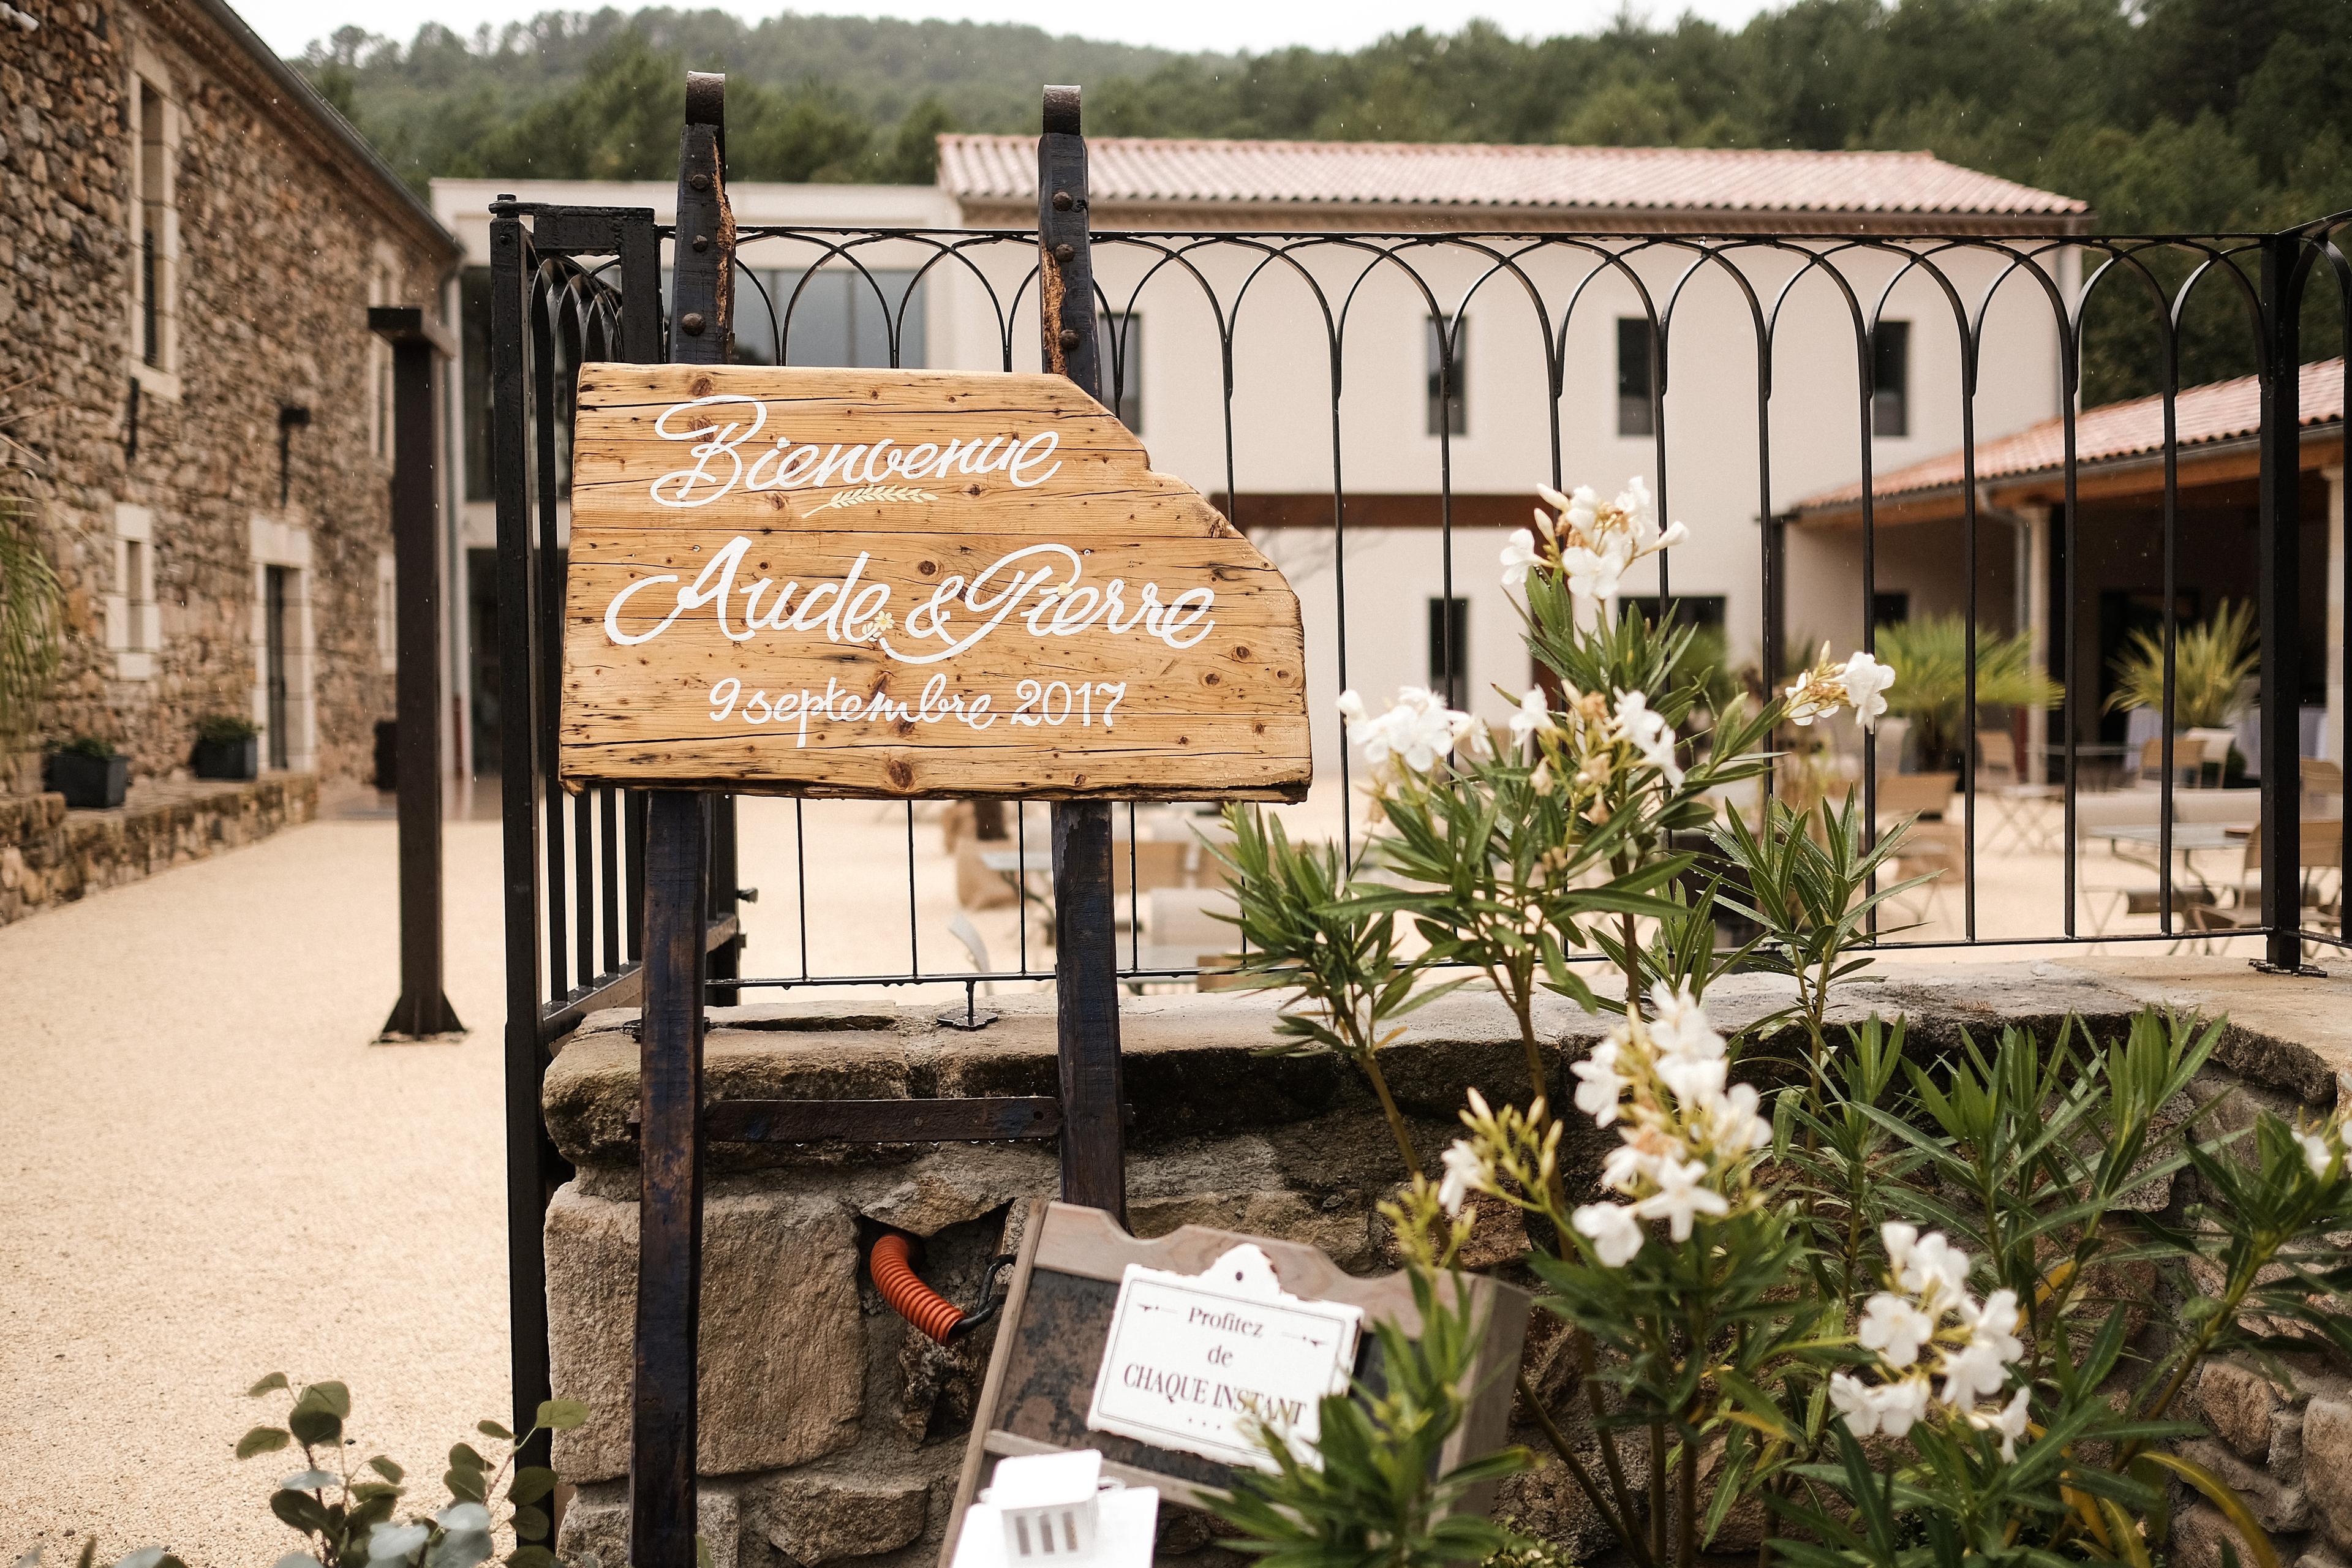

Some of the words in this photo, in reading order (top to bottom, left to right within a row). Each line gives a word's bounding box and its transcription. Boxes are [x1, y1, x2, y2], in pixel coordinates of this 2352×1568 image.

[649, 394, 1062, 507] Bienvenue
[604, 535, 892, 646] Aude
[880, 543, 1216, 664] Pierre
[905, 575, 964, 646] &
[709, 677, 741, 721] 9
[742, 673, 997, 748] septembre
[1010, 678, 1126, 726] 2017
[1188, 1306, 1264, 1338] Profitez
[1207, 1345, 1234, 1368] de
[1123, 1363, 1209, 1403] CHAQUE
[1212, 1384, 1307, 1425] INSTANT
